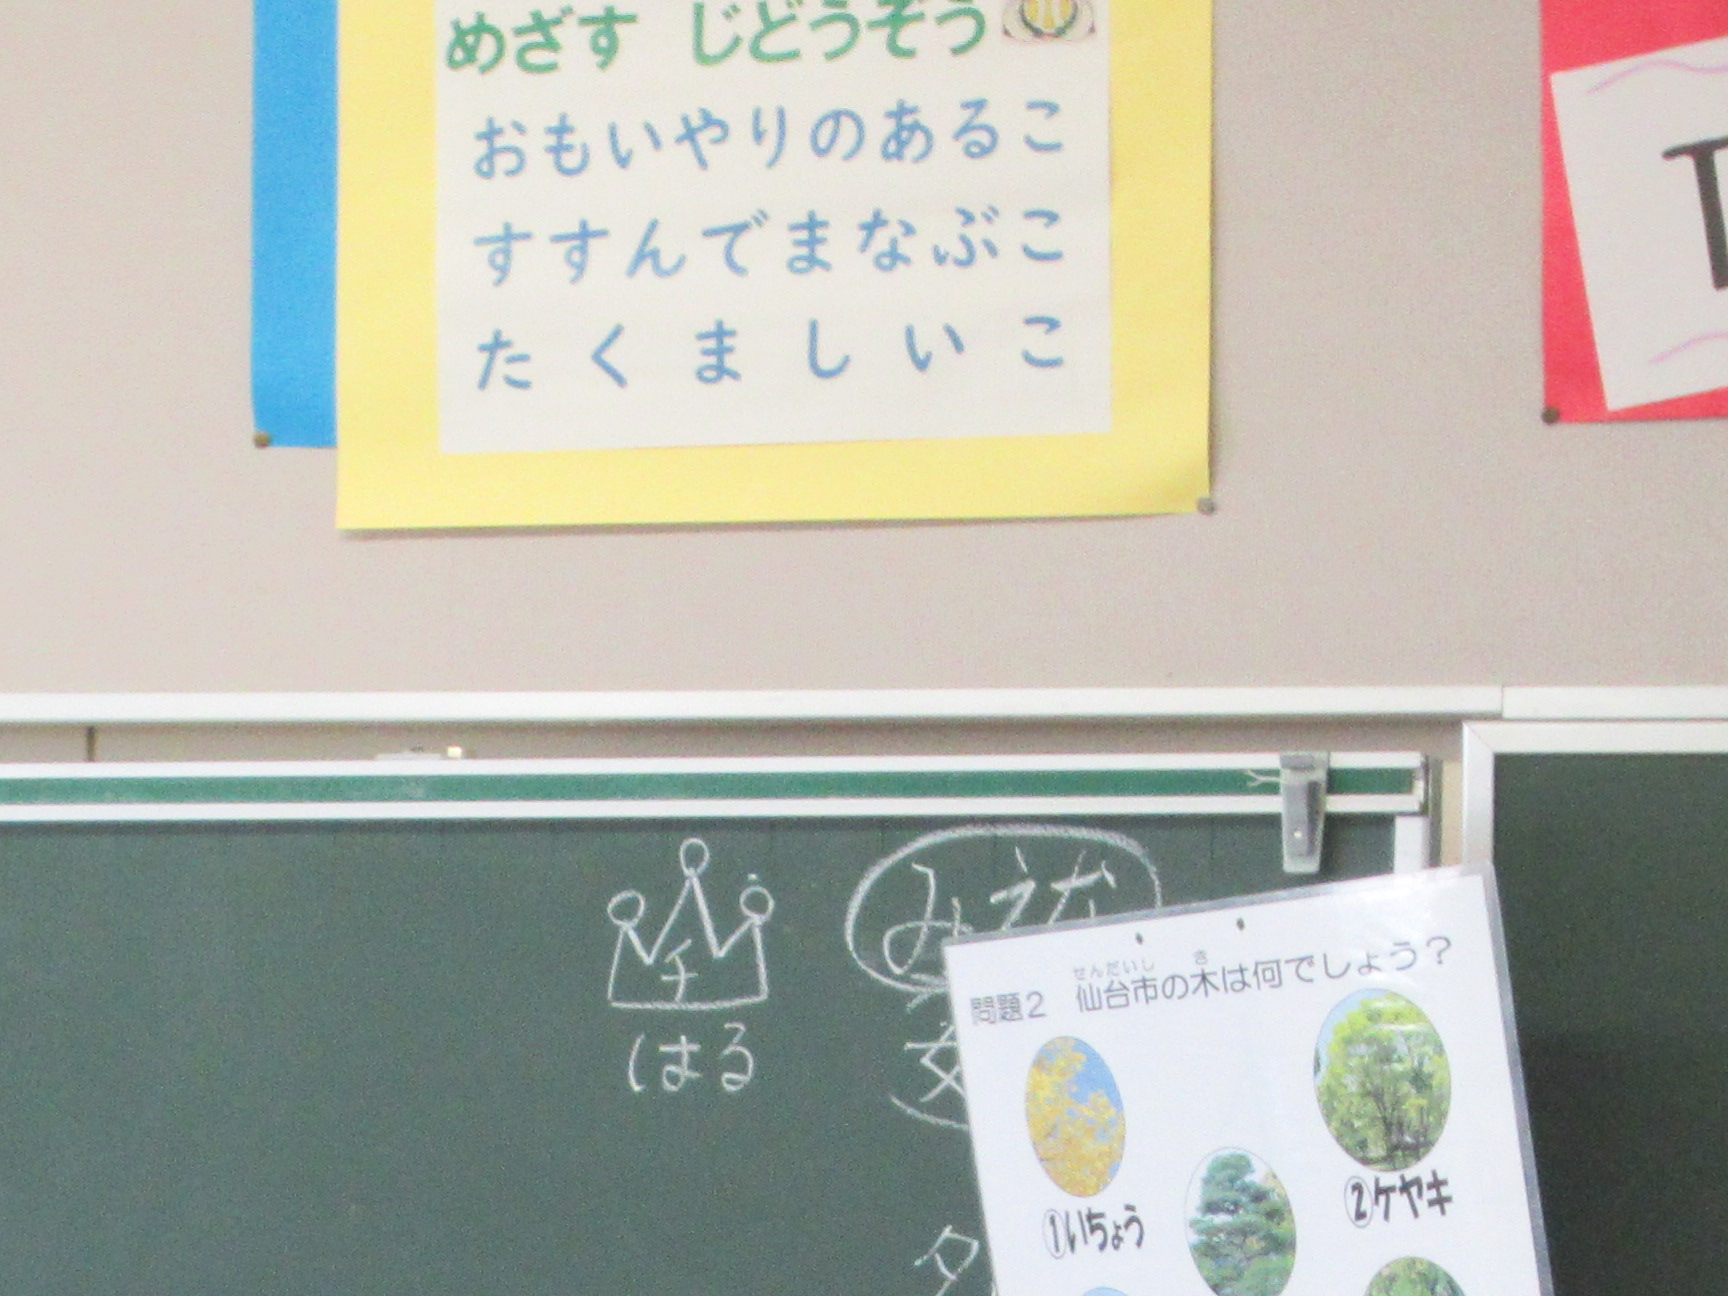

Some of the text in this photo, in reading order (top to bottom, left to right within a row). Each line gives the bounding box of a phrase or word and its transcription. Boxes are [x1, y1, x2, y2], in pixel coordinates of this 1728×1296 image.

[445, 6, 637, 76] めざす
[472, 97, 1066, 181] おもいやりのあるこ
[472, 206, 1066, 288] すすんでまなぶこ
[476, 314, 1066, 391] たくましいこ
[1075, 935, 1454, 1014] 仙台市の木は何でしょう？
[629, 1023, 754, 1092] はる
